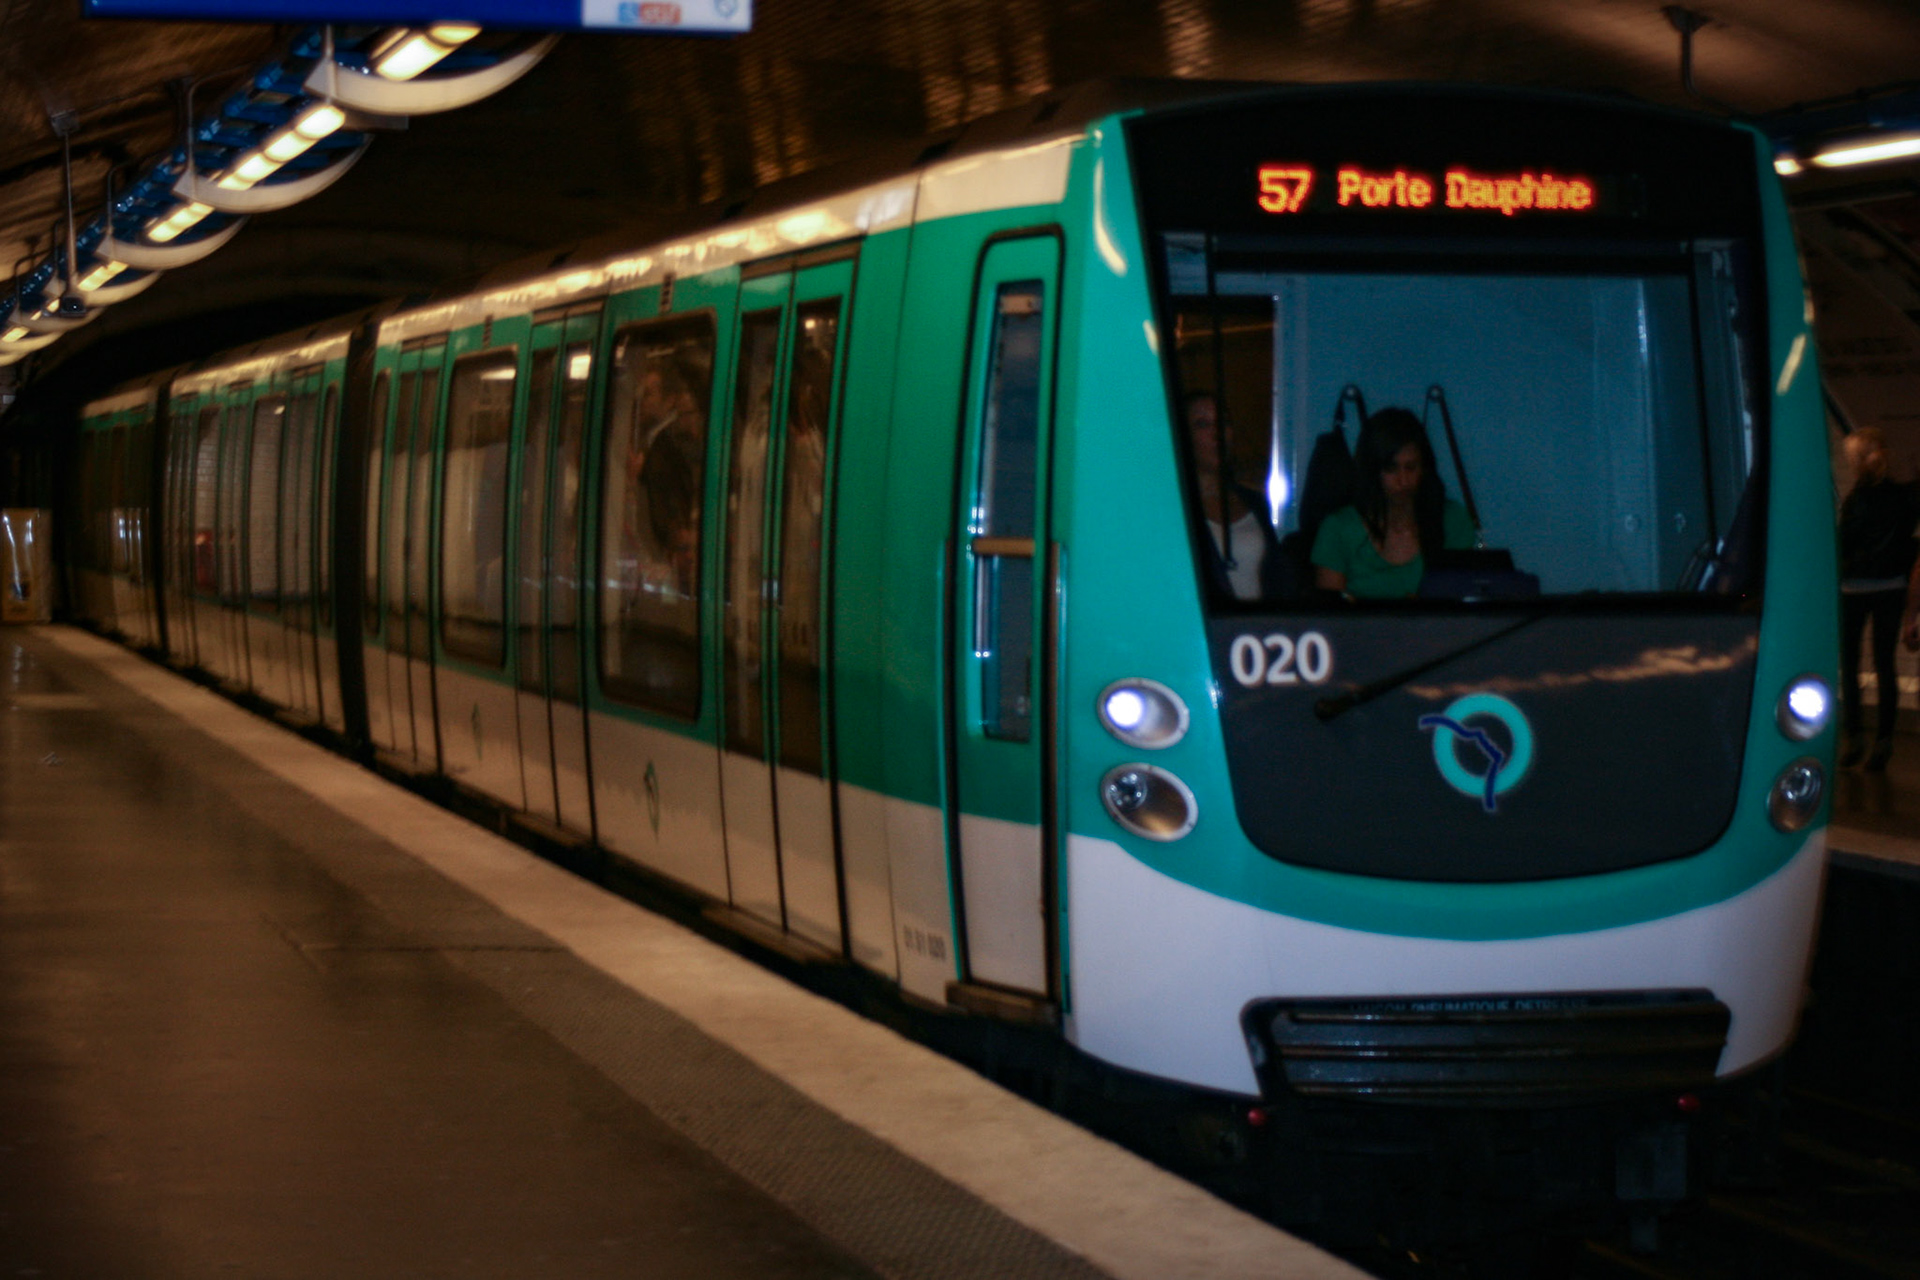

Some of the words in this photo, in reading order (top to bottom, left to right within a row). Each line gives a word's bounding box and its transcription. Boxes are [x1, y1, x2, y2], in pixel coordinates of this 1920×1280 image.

[1257, 168, 1312, 213] 57
[1337, 169, 1433, 207] Porte
[1444, 170, 1593, 216] Dauphine
[1230, 630, 1331, 687] 020
